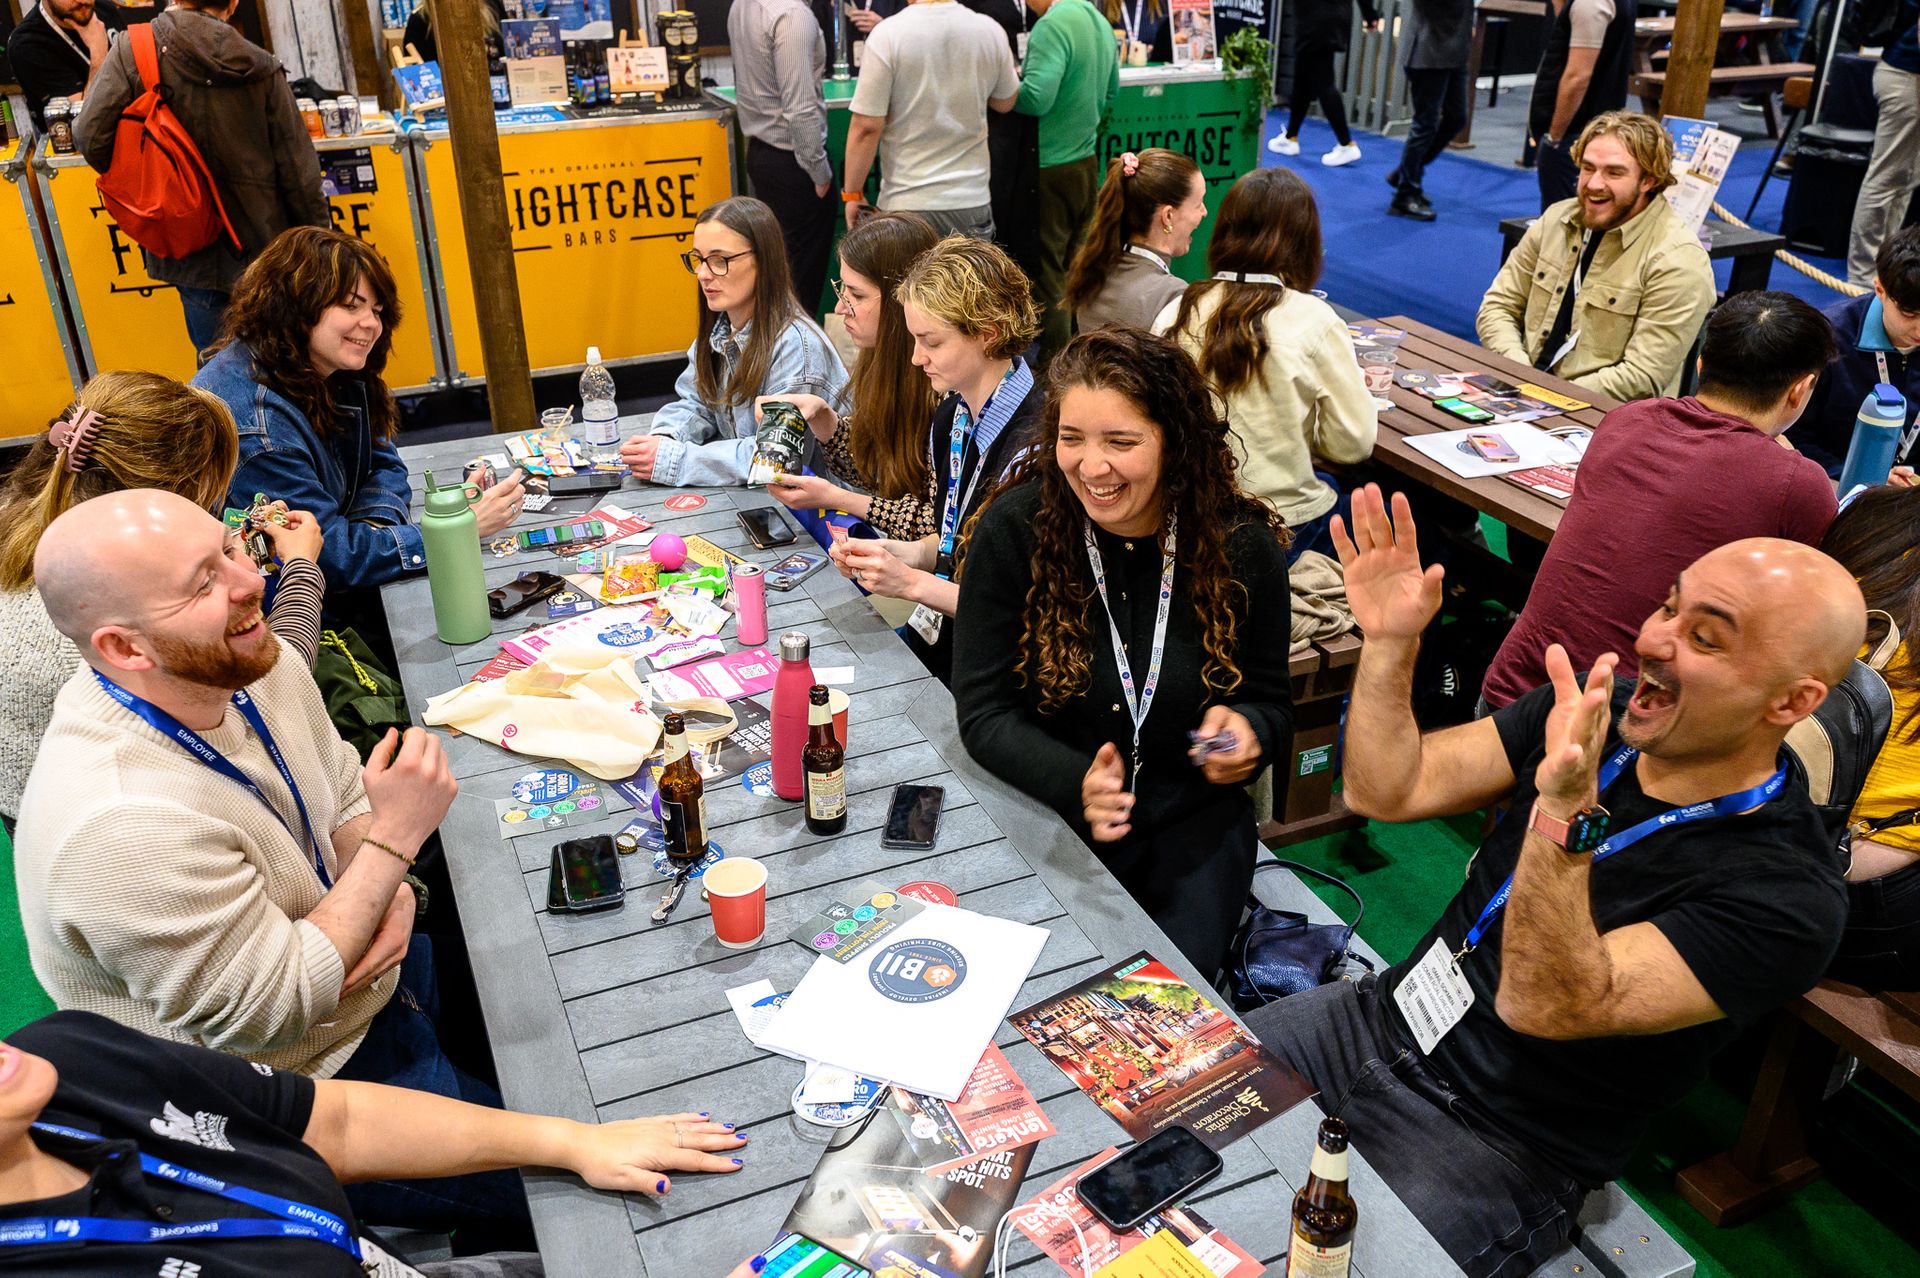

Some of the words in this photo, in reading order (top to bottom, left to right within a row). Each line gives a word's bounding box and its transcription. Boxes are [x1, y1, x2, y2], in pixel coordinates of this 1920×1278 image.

[1105, 126, 1234, 166] GHTCASE
[530, 167, 555, 175] THE
[566, 161, 635, 172] ORIGINAL
[511, 173, 698, 232] IGHTCASE
[565, 229, 617, 247] BARS
[107, 683, 134, 702] FLAVOUR
[177, 729, 217, 762] EMPLOYEE
[1681, 802, 1715, 816] FLAVOUR
[867, 922, 897, 945] PROUDLY
[842, 941, 870, 961] SHIPPED
[888, 939, 928, 952] THRIVING
[888, 992, 918, 1002] DEVELOP
[924, 988, 950, 1001] INSPIRE
[1237, 1071, 1250, 1083] your
[1248, 1066, 1264, 1076] Turn
[1181, 1095, 1209, 1113] Christmas
[1001, 1115, 1021, 1125] LONG
[1153, 1111, 1182, 1129] destination
[1192, 1100, 1242, 1130] Decorators
[1205, 1106, 1251, 1133] Christmas
[947, 1168, 987, 1189] SPOT.
[978, 1160, 1012, 1180] HITS
[186, 1171, 226, 1188] FLAVOUR
[287, 1205, 345, 1235] EMPLOYEE
[150, 1222, 219, 1241] EMPLOYEE
